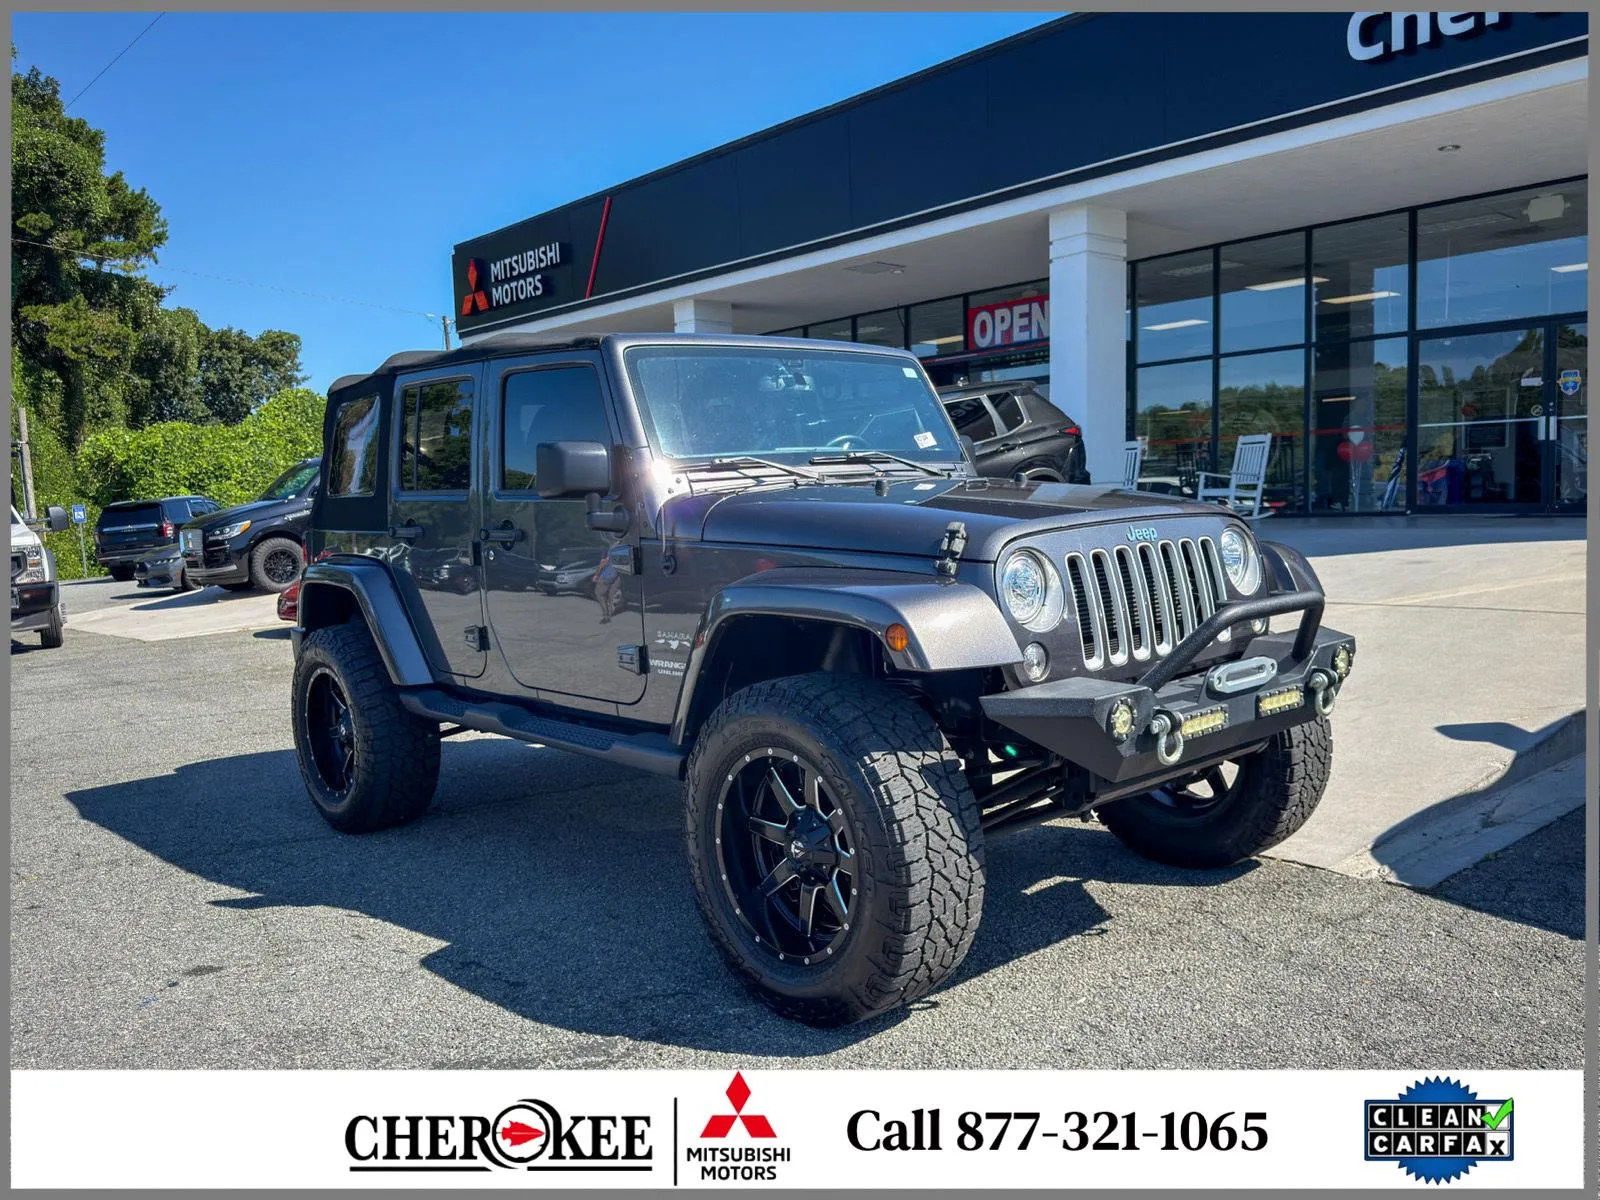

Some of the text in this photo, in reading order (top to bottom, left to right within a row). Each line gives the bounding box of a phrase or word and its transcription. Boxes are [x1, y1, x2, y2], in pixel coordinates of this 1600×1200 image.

[490, 242, 560, 283] MITSUBISHI
[491, 274, 543, 307] MOTORS
[973, 301, 1050, 348] OPEN
[1126, 524, 1158, 542] Jeep
